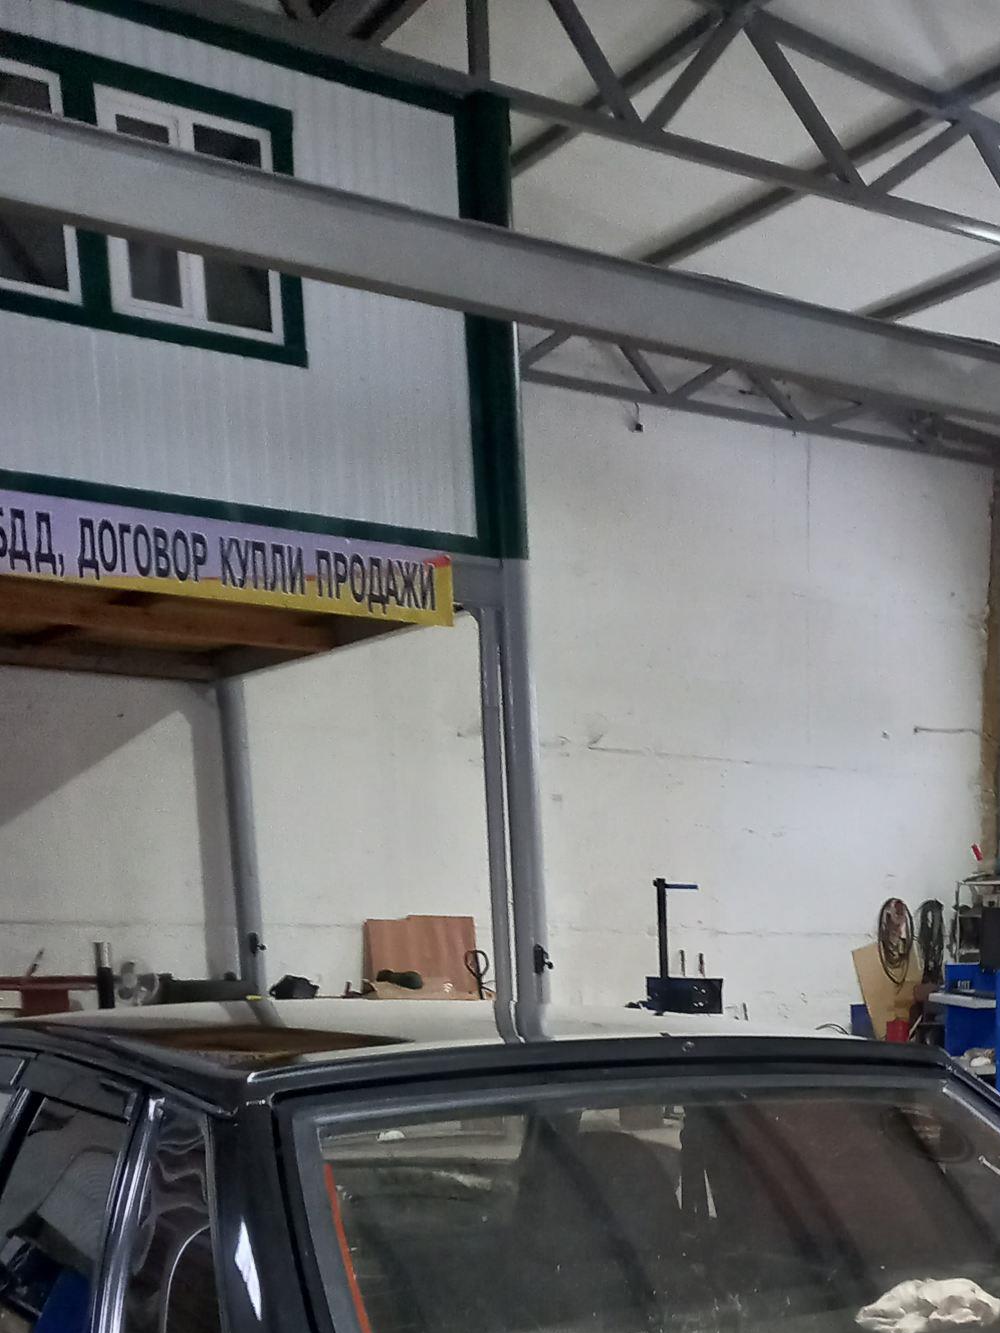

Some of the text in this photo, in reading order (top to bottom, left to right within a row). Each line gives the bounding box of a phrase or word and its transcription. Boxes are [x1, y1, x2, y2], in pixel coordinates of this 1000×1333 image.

[77, 517, 208, 583] ДОГОВОР
[219, 537, 305, 595] КУПЛИ
[315, 549, 436, 615] ПРОДАЖИ
